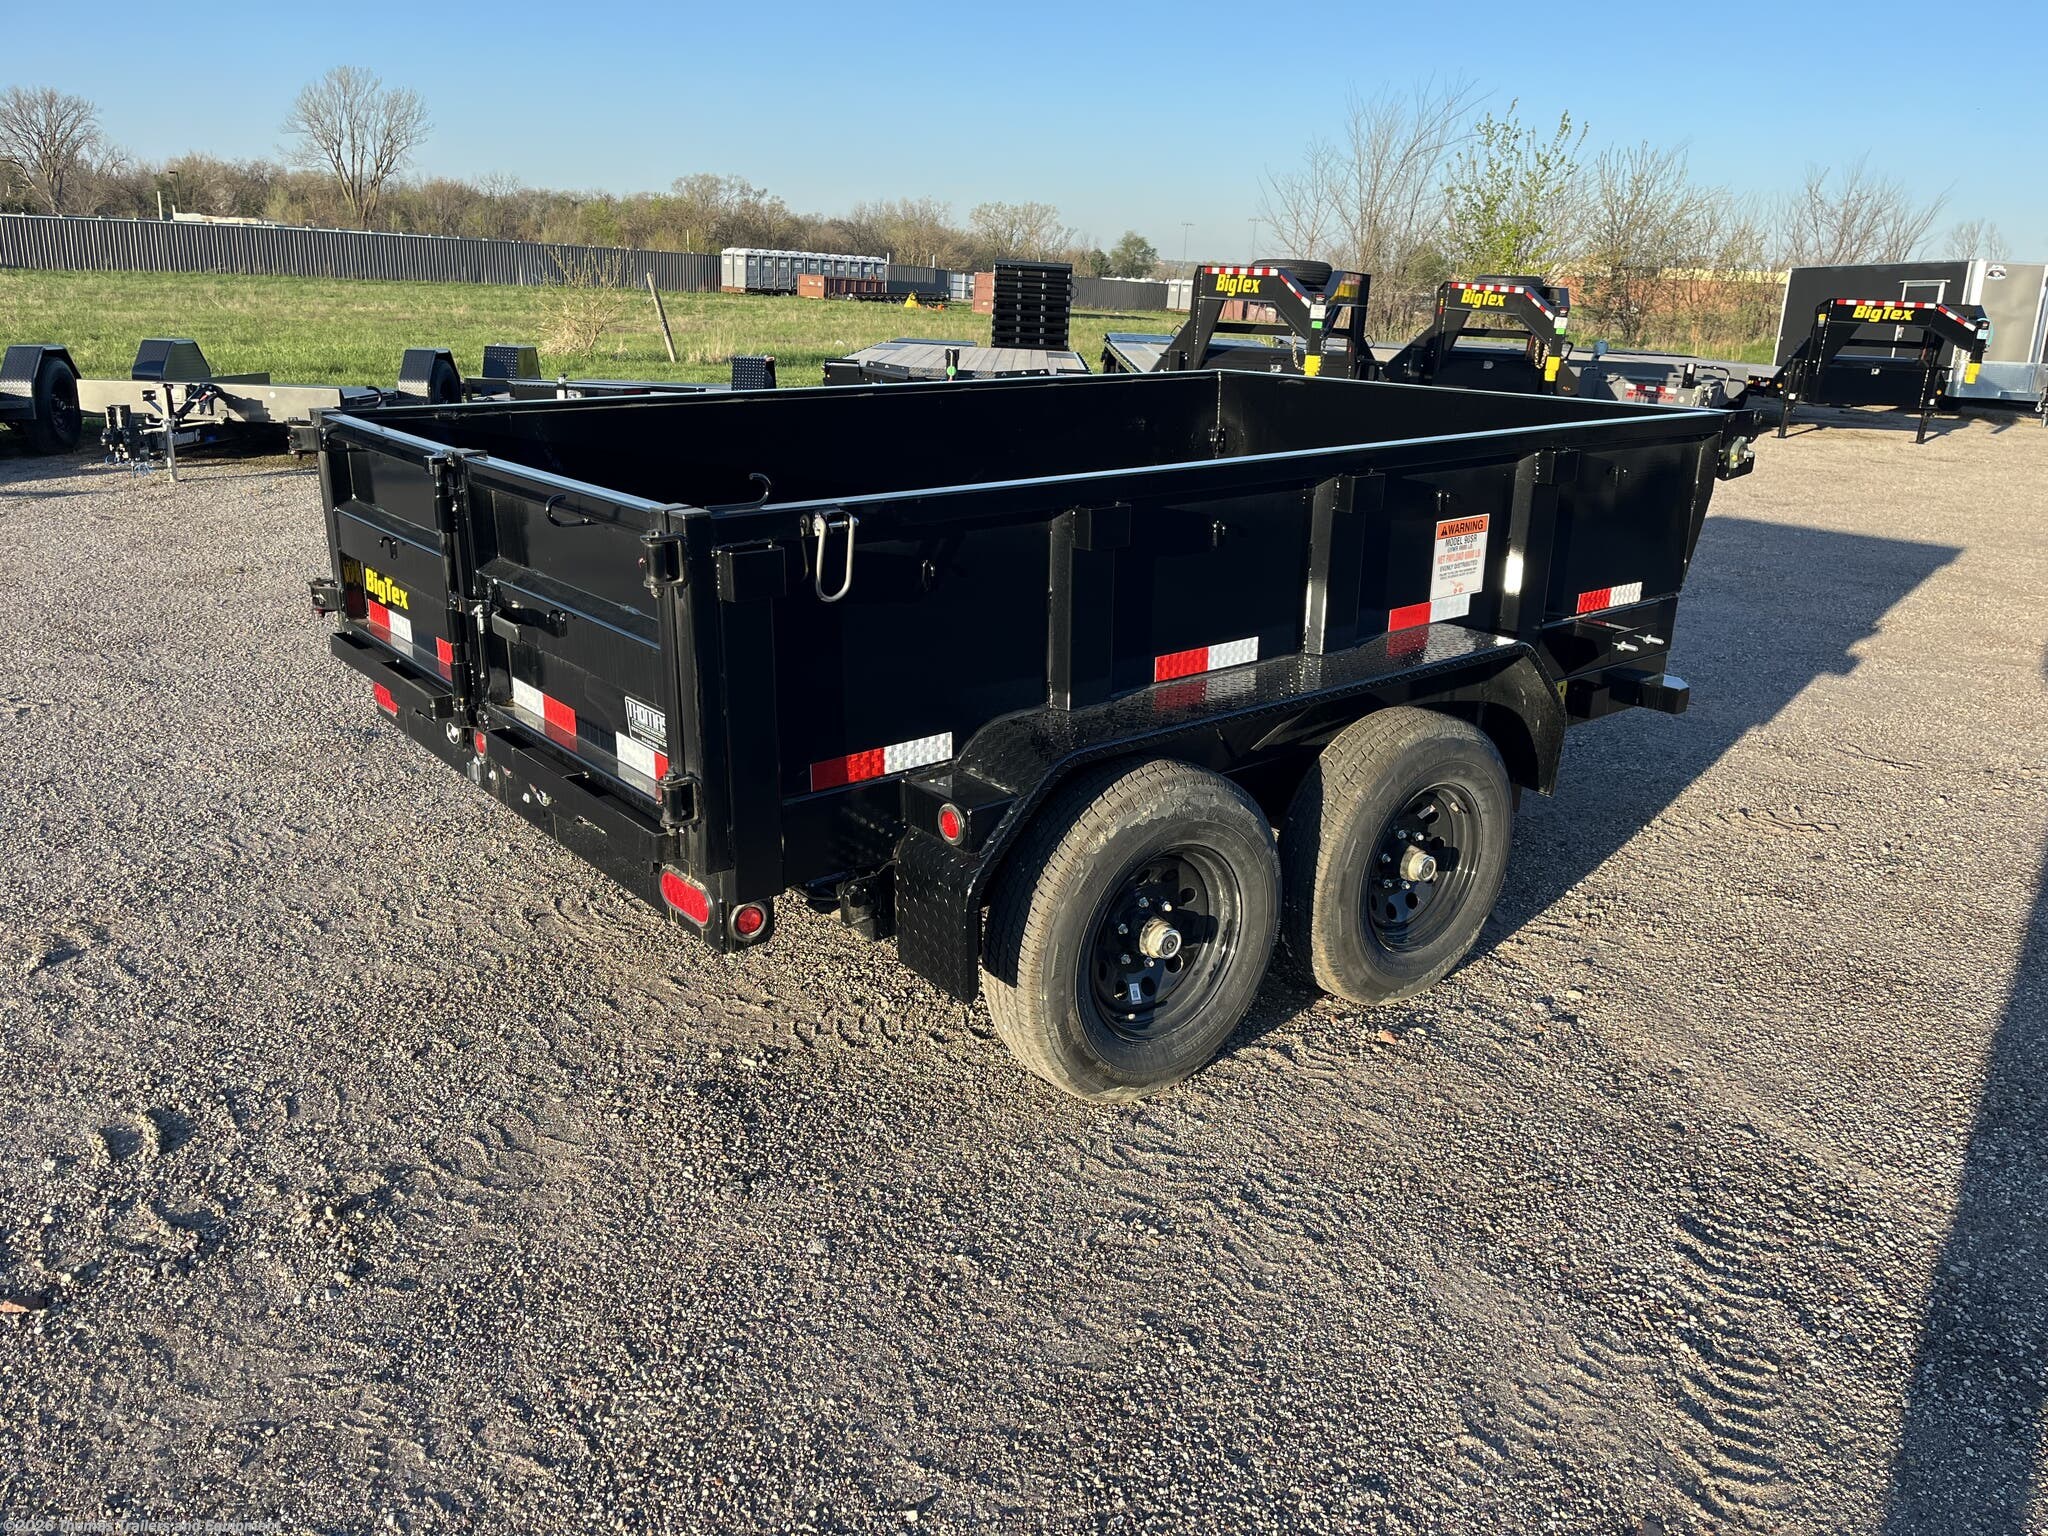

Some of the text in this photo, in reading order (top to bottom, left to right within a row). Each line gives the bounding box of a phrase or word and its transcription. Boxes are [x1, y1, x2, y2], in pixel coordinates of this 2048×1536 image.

[1216, 274, 1261, 297] BigTex
[1461, 288, 1506, 308] BigTex
[1852, 305, 1915, 322] BigTex
[1448, 520, 1483, 534] WARNING
[1445, 536, 1463, 547] MODEL
[365, 567, 409, 610] BigTex
